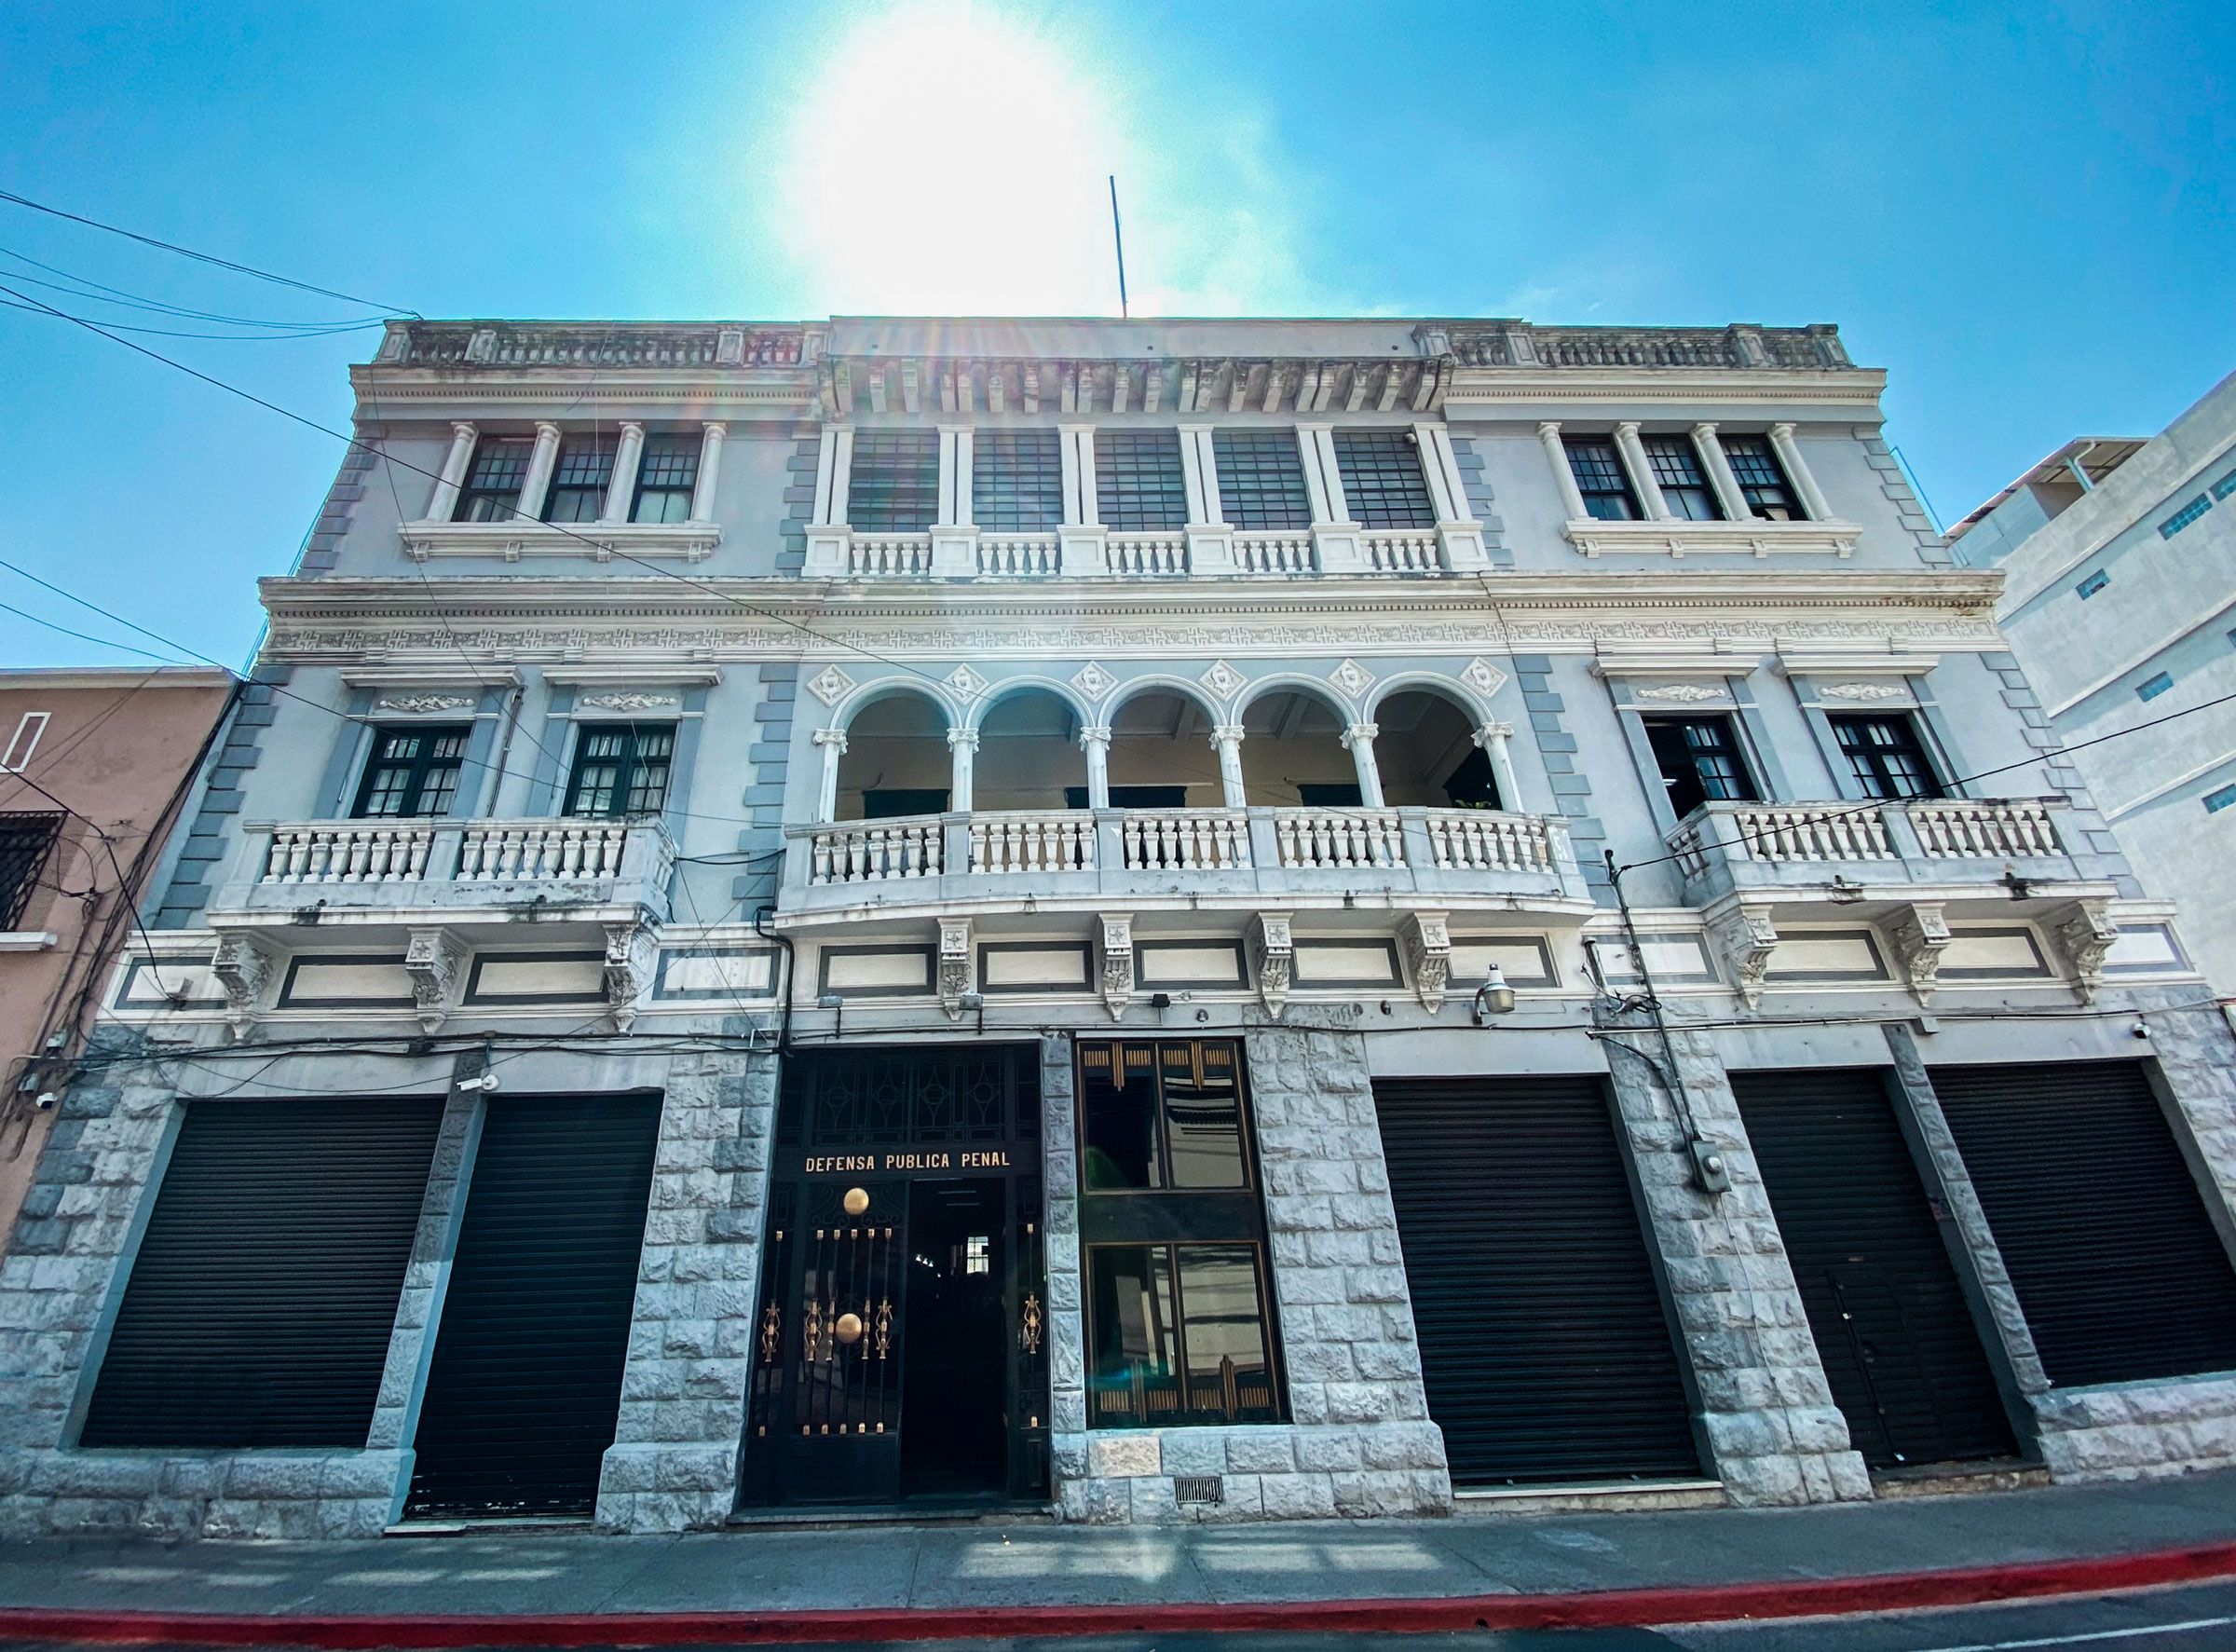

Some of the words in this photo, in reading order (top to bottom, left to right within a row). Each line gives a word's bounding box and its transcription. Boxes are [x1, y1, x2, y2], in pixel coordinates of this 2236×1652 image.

[805, 1155, 875, 1172] DEFENSA
[885, 1154, 949, 1169] PUBLICA
[961, 1152, 1011, 1167] PENAL
